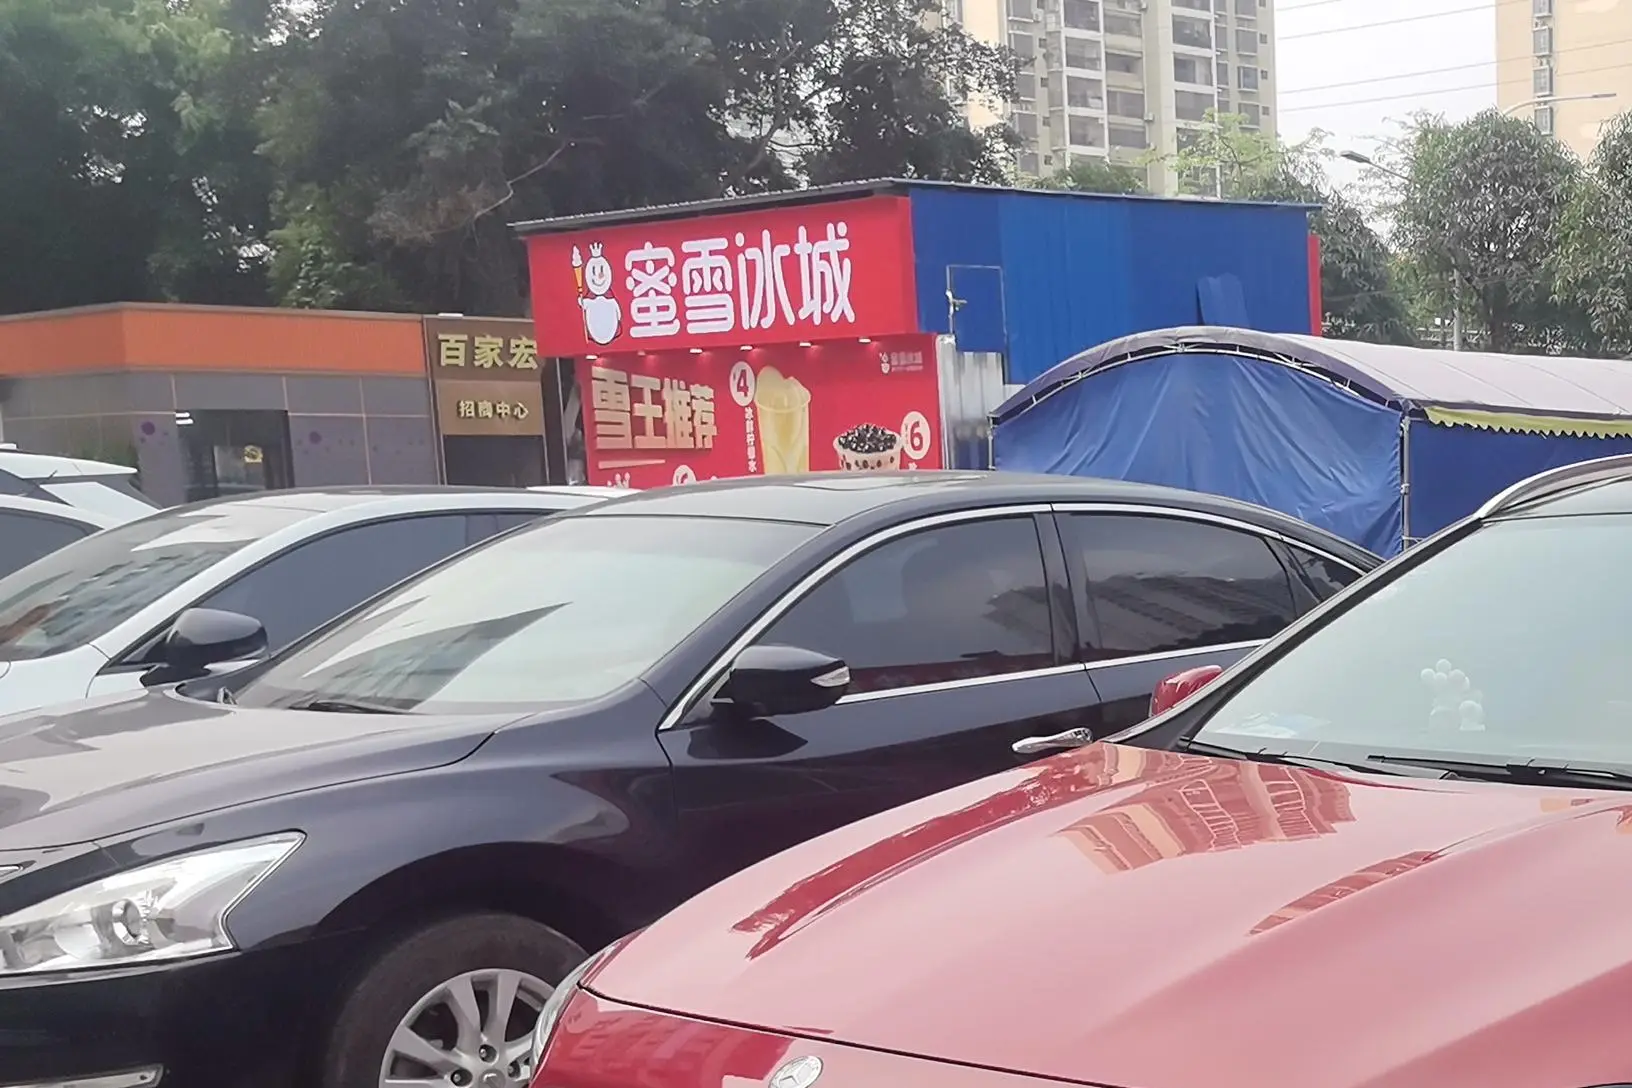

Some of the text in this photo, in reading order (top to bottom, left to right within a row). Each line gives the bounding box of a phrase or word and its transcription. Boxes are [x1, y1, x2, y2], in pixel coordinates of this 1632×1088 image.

[625, 221, 856, 338] 蜜雪冰城
[438, 332, 539, 369] 百家宏
[458, 400, 529, 419] 招商中心
[592, 366, 717, 449] 雪王推荐
